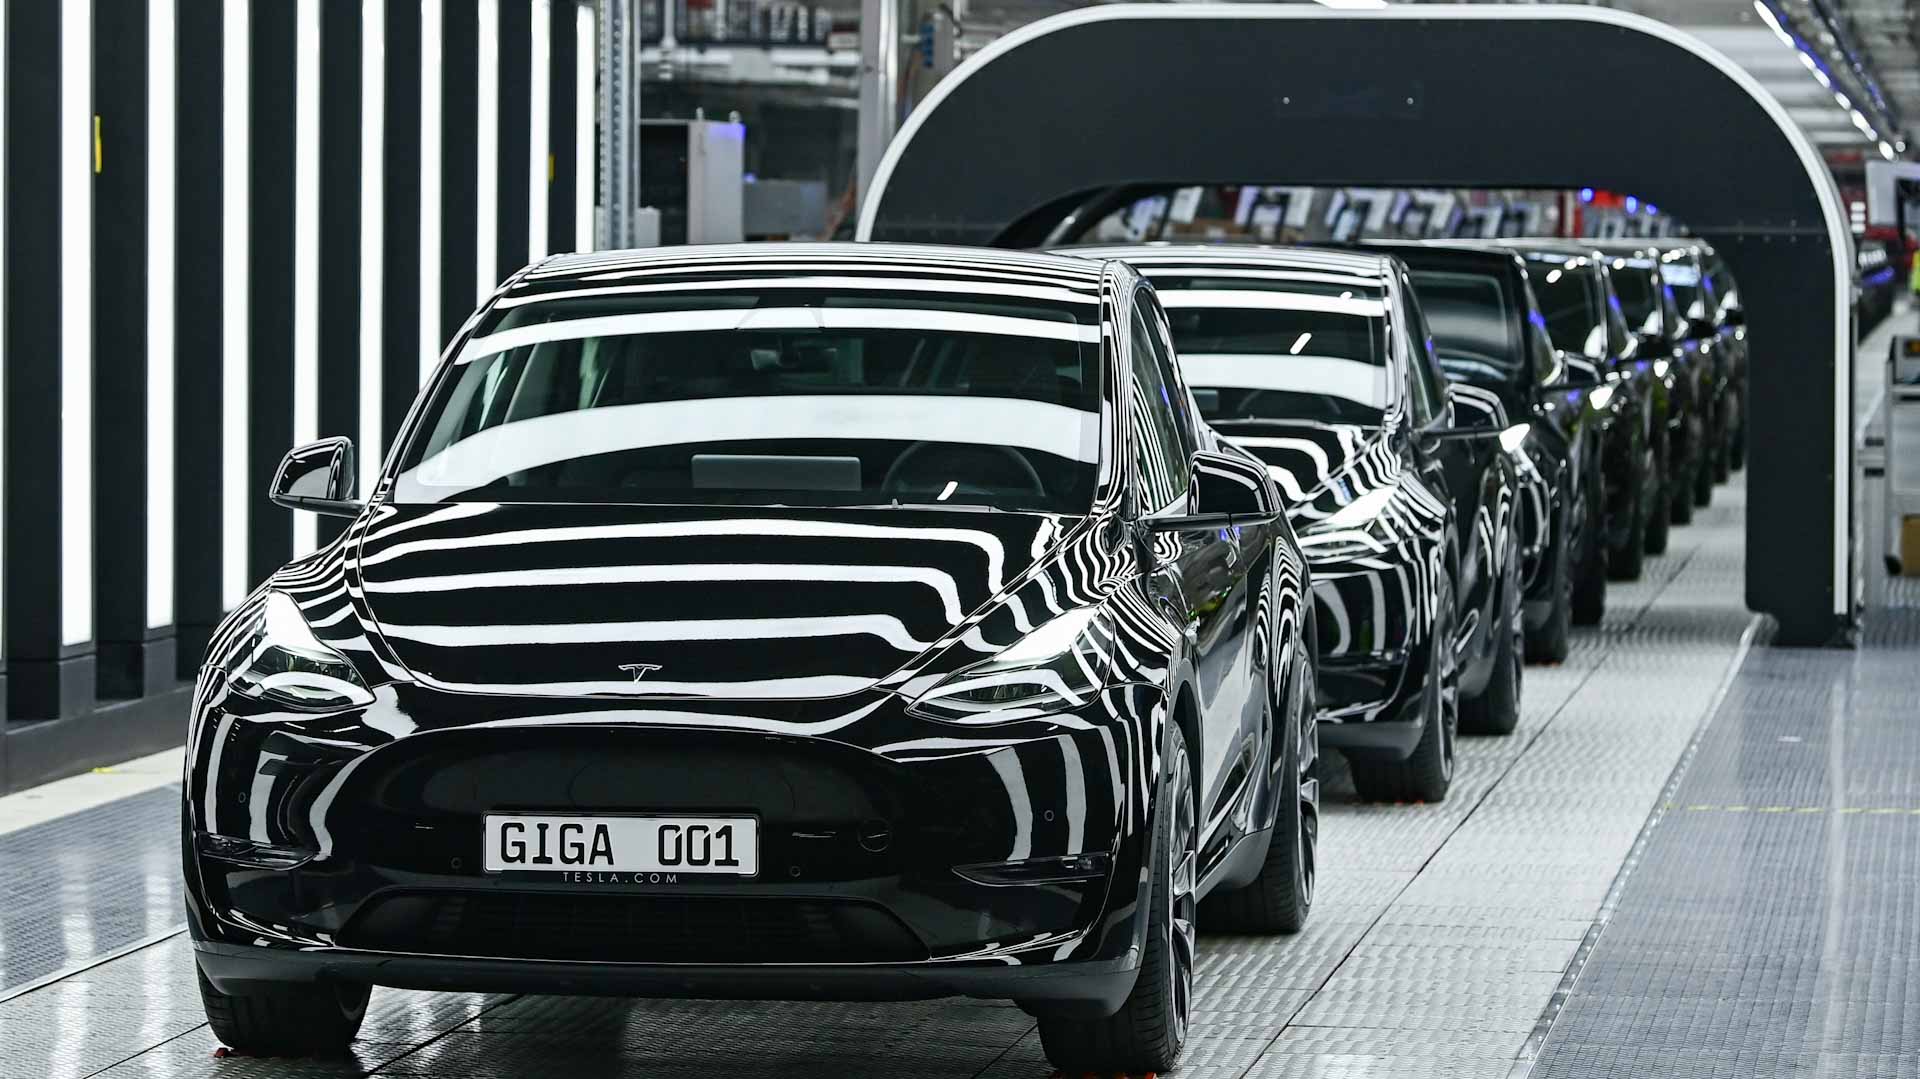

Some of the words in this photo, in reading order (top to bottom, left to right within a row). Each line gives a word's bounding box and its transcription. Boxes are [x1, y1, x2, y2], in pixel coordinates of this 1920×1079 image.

[500, 822, 614, 865] GIGA
[658, 825, 739, 867] 001
[562, 872, 677, 884] TESLA.COM
